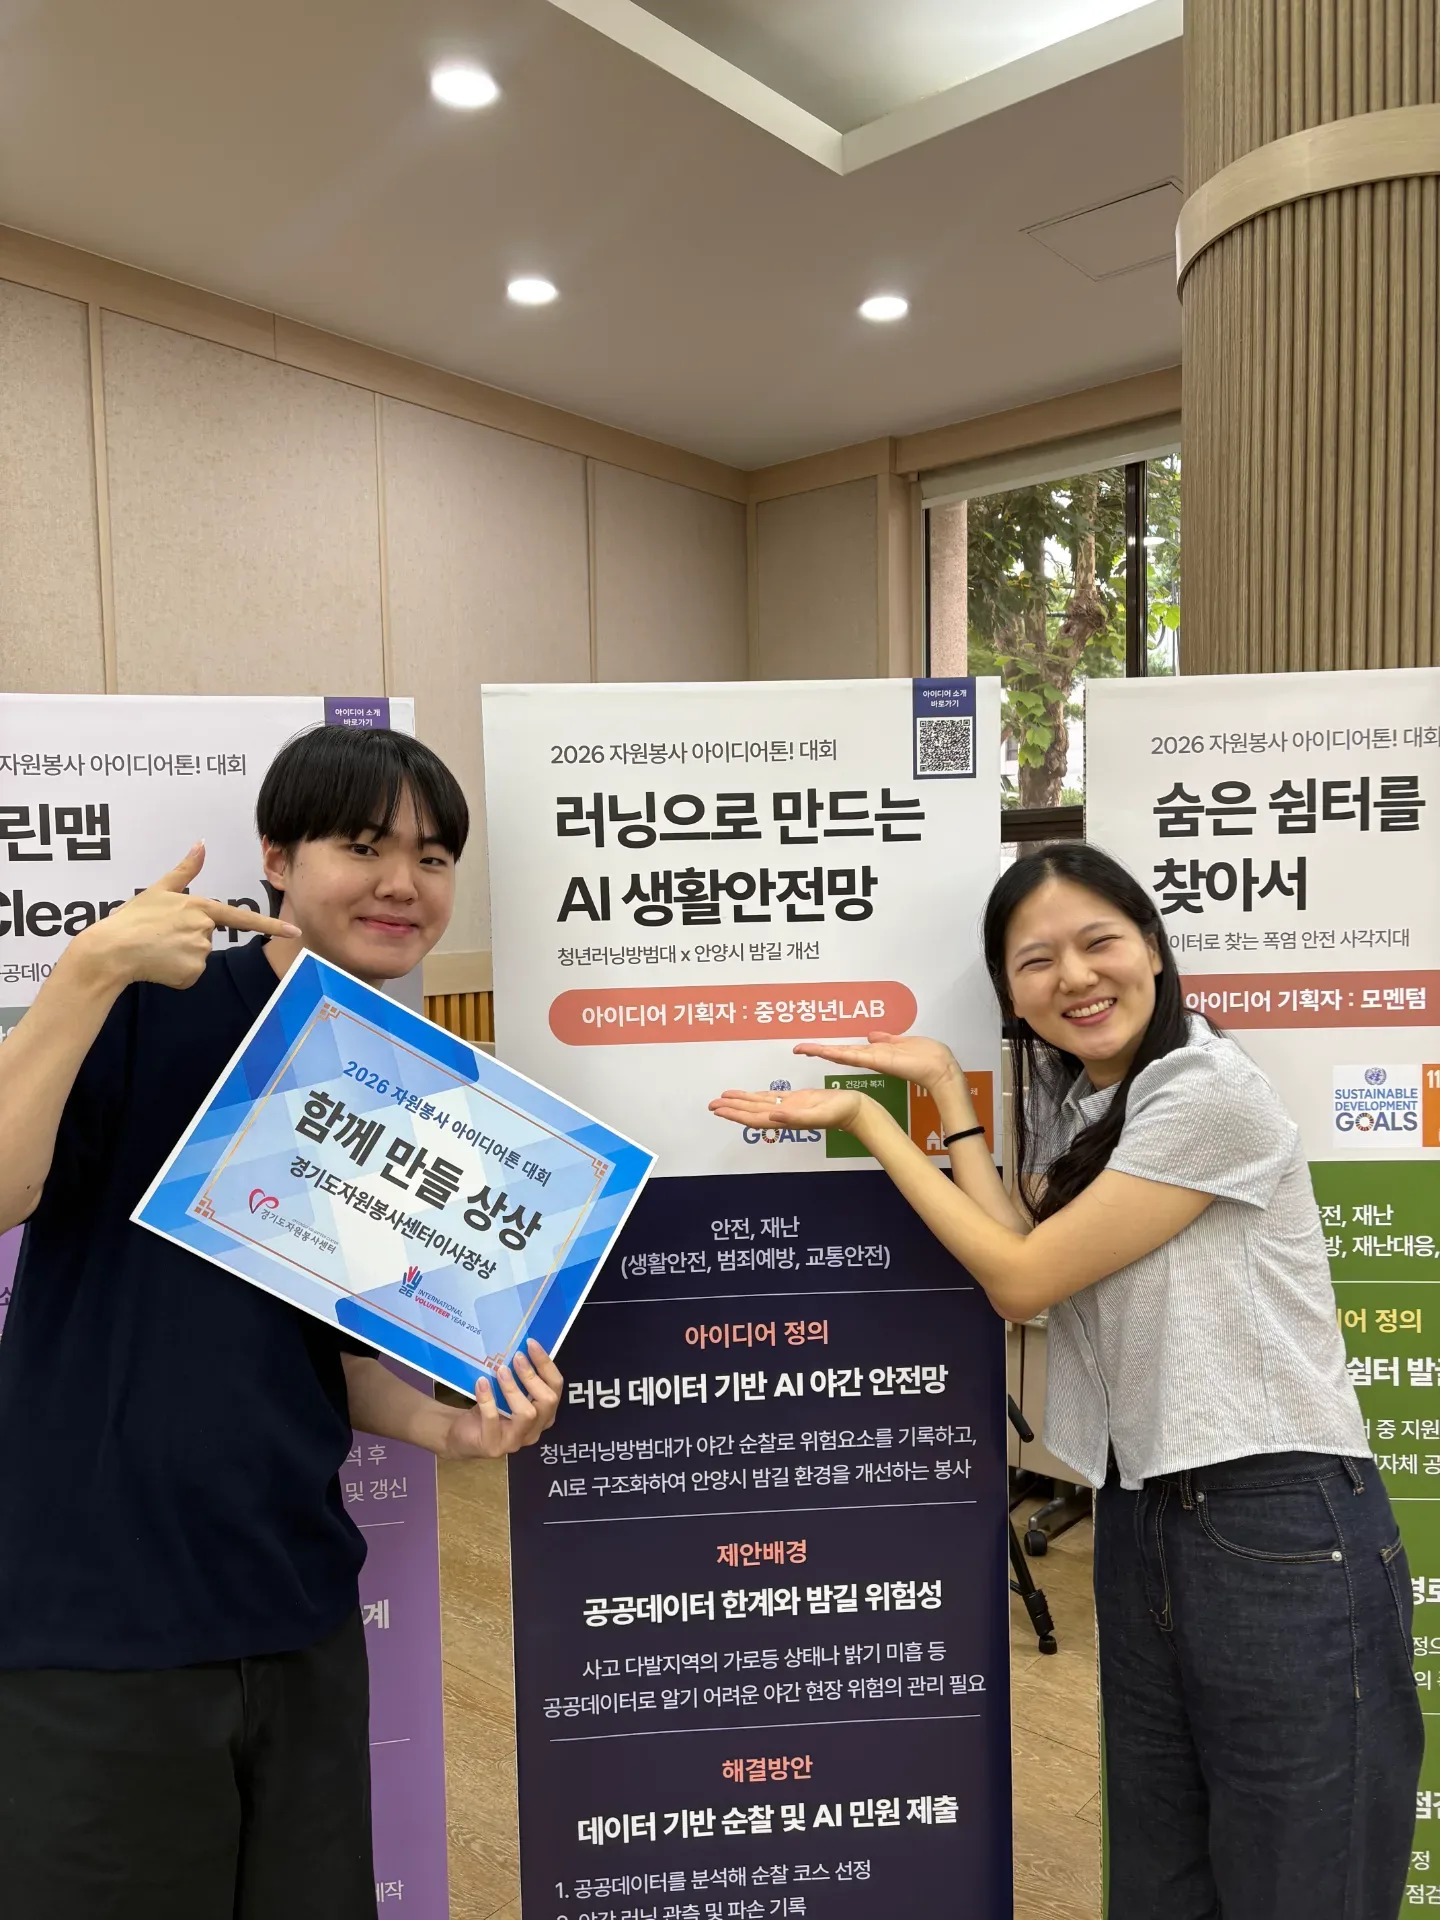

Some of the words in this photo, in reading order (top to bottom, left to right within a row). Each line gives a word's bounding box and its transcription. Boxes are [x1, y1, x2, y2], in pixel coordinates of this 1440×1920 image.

[923, 690, 951, 698] 아이디어
[952, 689, 967, 698] 소개
[930, 700, 959, 708] 바로가기
[334, 708, 364, 717] 아이디어
[366, 708, 380, 717] 소개
[343, 718, 373, 726] 바로가기
[551, 744, 604, 765] 2026
[609, 742, 687, 764] 자원봉사
[692, 740, 794, 763] 아이디어톤!
[799, 738, 837, 761] 대회
[1151, 735, 1204, 755] 2026
[1209, 733, 1287, 756] 자원봉사
[1292, 729, 1398, 753] 아이디어톤!
[1403, 725, 1440, 748] 대회
[0, 753, 85, 776] 자원봉사
[90, 753, 202, 777] 아이디어톤!
[207, 753, 247, 776] 대회
[556, 791, 762, 849] 러닝으로
[772, 787, 925, 845] 만드는
[1153, 780, 1257, 839] 숨은
[1268, 775, 1427, 834] 쉼터를
[556, 876, 611, 923] AI
[621, 865, 878, 928] 생활안전망
[1152, 856, 1307, 917] 찾아서
[557, 944, 677, 968] 청년러닝방범대
[694, 942, 745, 964] 안양시
[749, 941, 782, 963] 밤길
[786, 940, 820, 962] 개선
[1169, 933, 1221, 953] 이터로
[1224, 931, 1259, 952] 찾는
[1263, 930, 1297, 951] 폭염
[1301, 930, 1336, 950] 안전
[1340, 929, 1411, 949] 사각지대
[581, 1003, 668, 1029] 아이디어
[673, 1001, 736, 1027] 기획자
[754, 998, 885, 1025] 중앙청년LAB
[1185, 990, 1271, 1013] 아이디어
[1277, 988, 1342, 1011] 기획자
[1360, 986, 1427, 1010] 모멘텀
[845, 1079, 868, 1089] 건강과
[869, 1079, 885, 1088] 복지
[1334, 1088, 1418, 1100] SUSTAINABLE
[1335, 1101, 1418, 1111] DEVELOPMENT
[342, 1060, 390, 1095] 2026
[390, 1086, 452, 1131] 자원봉사
[451, 1114, 522, 1171] 아이디어톤
[521, 1155, 552, 1187] 대회
[1335, 1112, 1418, 1132] GOALS
[294, 1089, 386, 1168] 함께
[378, 1134, 466, 1213] 만들
[463, 1188, 543, 1252] 상상
[260, 1208, 337, 1254] 경기도자원봉사센터
[288, 1154, 498, 1281] 경기도자원봉사센터이사장상
[710, 1218, 755, 1242] 안전,
[760, 1216, 801, 1239] 재난
[1316, 1205, 1347, 1229] 전,
[1351, 1204, 1394, 1227] 재난
[620, 1250, 713, 1279] (생활안전,
[716, 1247, 801, 1272] 범죄예방,
[805, 1244, 891, 1271] 교통안전)
[1351, 1235, 1440, 1258] 재난대응,
[414, 1295, 451, 1318] VOLUNTEER
[450, 1315, 467, 1328] YEAR
[466, 1323, 482, 1336] 2026
[417, 1288, 464, 1318] INTERNATIONAL
[685, 1321, 777, 1350] 아이디어
[783, 1319, 829, 1347] 정의
[1375, 1308, 1422, 1334] 정의
[1346, 1355, 1400, 1387] 쉼터
[568, 1377, 622, 1411] 러닝
[628, 1373, 708, 1407] 데이터
[714, 1371, 767, 1404] 기반
[774, 1373, 804, 1398] AI
[809, 1367, 863, 1401] 야간
[868, 1364, 949, 1397] 안전망
[1375, 1419, 1397, 1440] 중
[367, 1445, 388, 1466] 후
[539, 1436, 692, 1466] 청년러닝방범대가
[696, 1434, 734, 1458] 야간
[738, 1430, 796, 1455] 순찰로
[799, 1427, 894, 1454] 위험요소를
[897, 1424, 977, 1449] 기록하고,
[548, 1477, 588, 1499] AI로
[591, 1470, 686, 1497] 구조화하여
[690, 1469, 747, 1493] 안양시
[752, 1466, 790, 1489] 밤길
[794, 1465, 851, 1488] 환경을
[855, 1461, 930, 1486] 개선하는
[933, 1458, 972, 1482] 봉사
[1373, 1453, 1418, 1475] 자체
[345, 1482, 364, 1503] 및
[369, 1477, 408, 1500] 갱신
[716, 1539, 808, 1569] 제안배경
[361, 1598, 390, 1632] 계
[582, 1590, 715, 1628] 공공데이터
[720, 1586, 800, 1620] 한계와
[805, 1582, 858, 1616] 밤길
[864, 1579, 942, 1612] 위험성
[582, 1658, 621, 1681] 사고
[624, 1651, 719, 1680] 다발지역의
[722, 1648, 780, 1674] 가로등
[783, 1645, 840, 1671] 상태나
[843, 1642, 881, 1667] 밝기
[885, 1641, 923, 1664] 미흡
[927, 1640, 947, 1661] 등
[542, 1691, 657, 1719] 공공데이터로
[660, 1687, 699, 1711] 알기
[702, 1684, 760, 1709] 어려운
[763, 1681, 801, 1705] 야간
[805, 1679, 842, 1702] 현장
[846, 1676, 903, 1701] 위험의
[906, 1674, 944, 1698] 관리
[948, 1673, 987, 1696] 필요
[721, 1754, 813, 1783] 해결방안
[576, 1811, 657, 1847] 데이터
[663, 1808, 716, 1840] 기반
[721, 1804, 774, 1836] 순찰
[780, 1802, 805, 1832] 및
[812, 1802, 843, 1829] AI
[848, 1797, 901, 1829] 민원
[905, 1794, 959, 1826] 제출
[555, 1880, 569, 1899] 1.
[573, 1870, 687, 1899] 공공데이터를
[690, 1866, 747, 1890] 분석해
[751, 1862, 789, 1886] 순찰
[792, 1862, 831, 1883] 코스
[834, 1859, 872, 1881] 선정
[704, 1901, 723, 1920] 및
[727, 1898, 765, 1920] 파손
[768, 1896, 807, 1918] 기록
